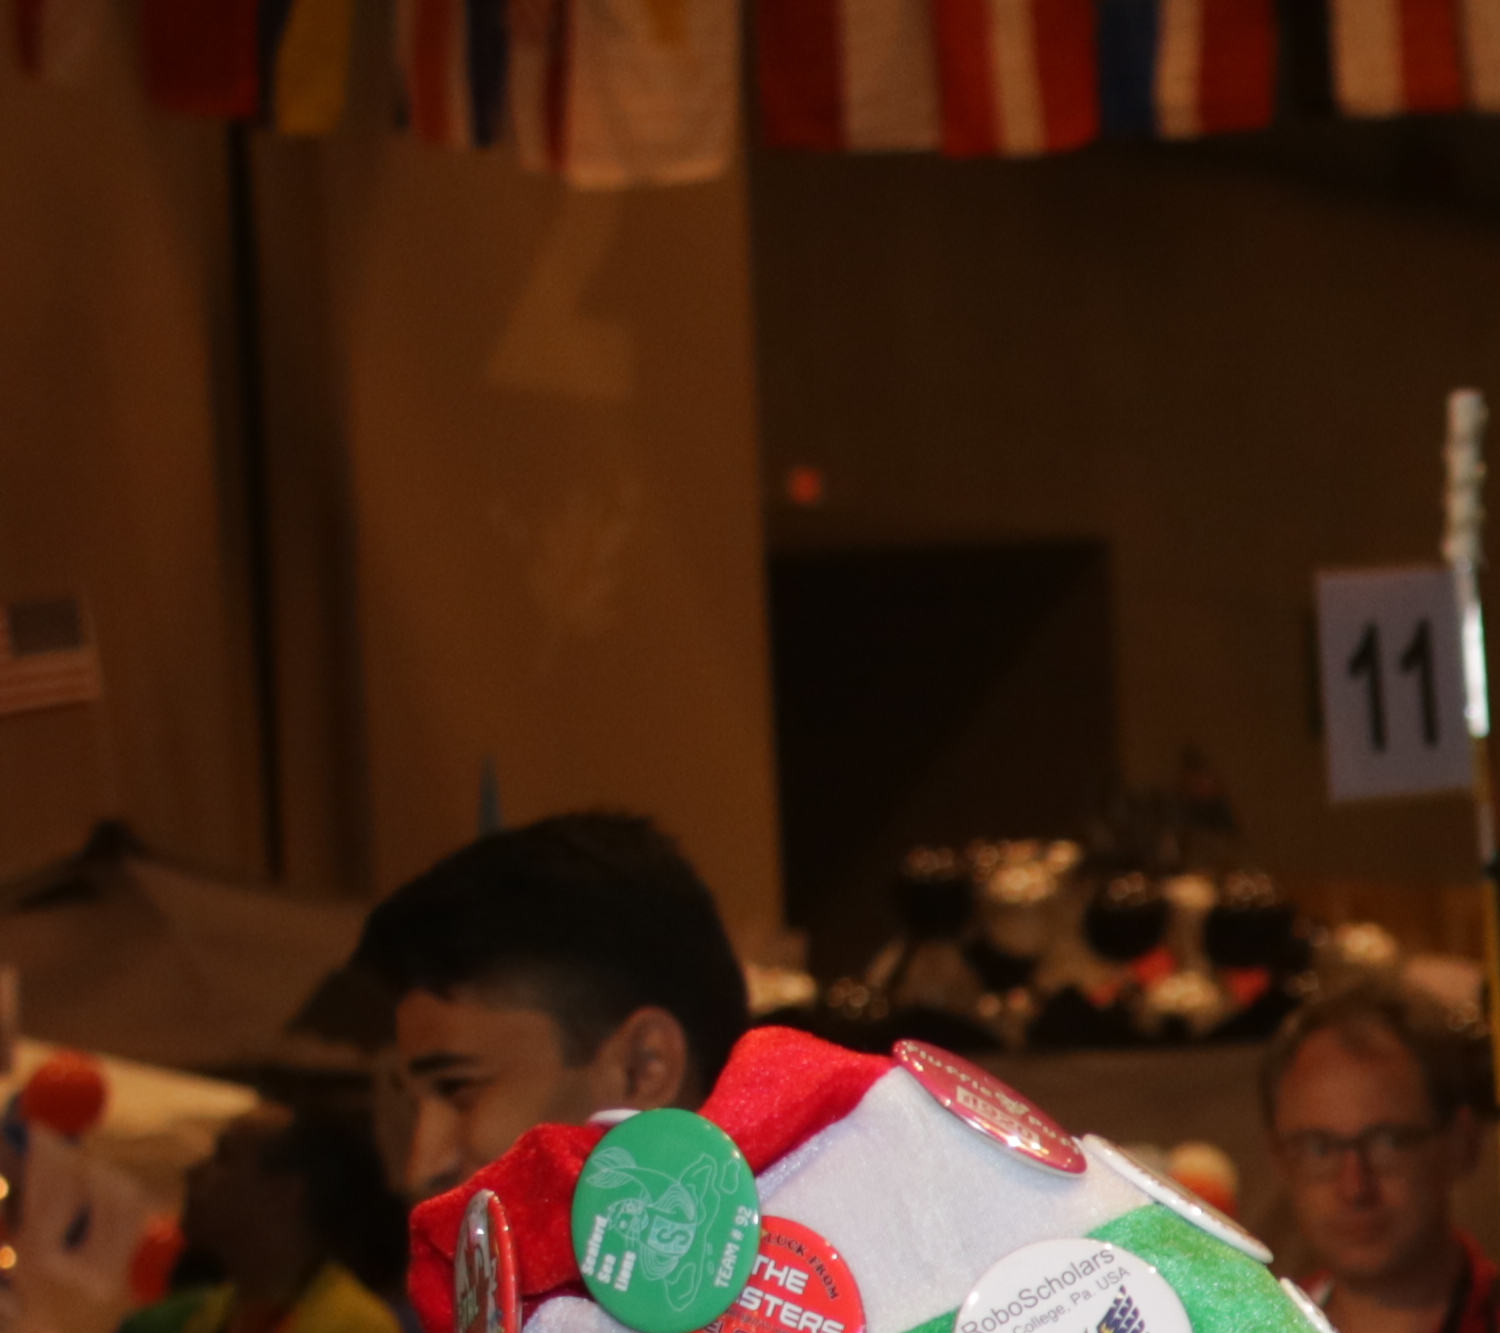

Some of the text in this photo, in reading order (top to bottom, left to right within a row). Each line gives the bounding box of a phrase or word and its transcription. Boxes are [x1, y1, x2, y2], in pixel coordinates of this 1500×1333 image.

[1348, 617, 1438, 752] 11
[713, 1241, 741, 1288] TEAM
[734, 1205, 753, 1227] 92
[764, 1232, 839, 1300] LUCK FROM
[597, 1253, 616, 1284] Sea
[614, 1250, 637, 1292] Lions
[751, 1254, 809, 1295] THE
[1096, 1265, 1132, 1292] USA
